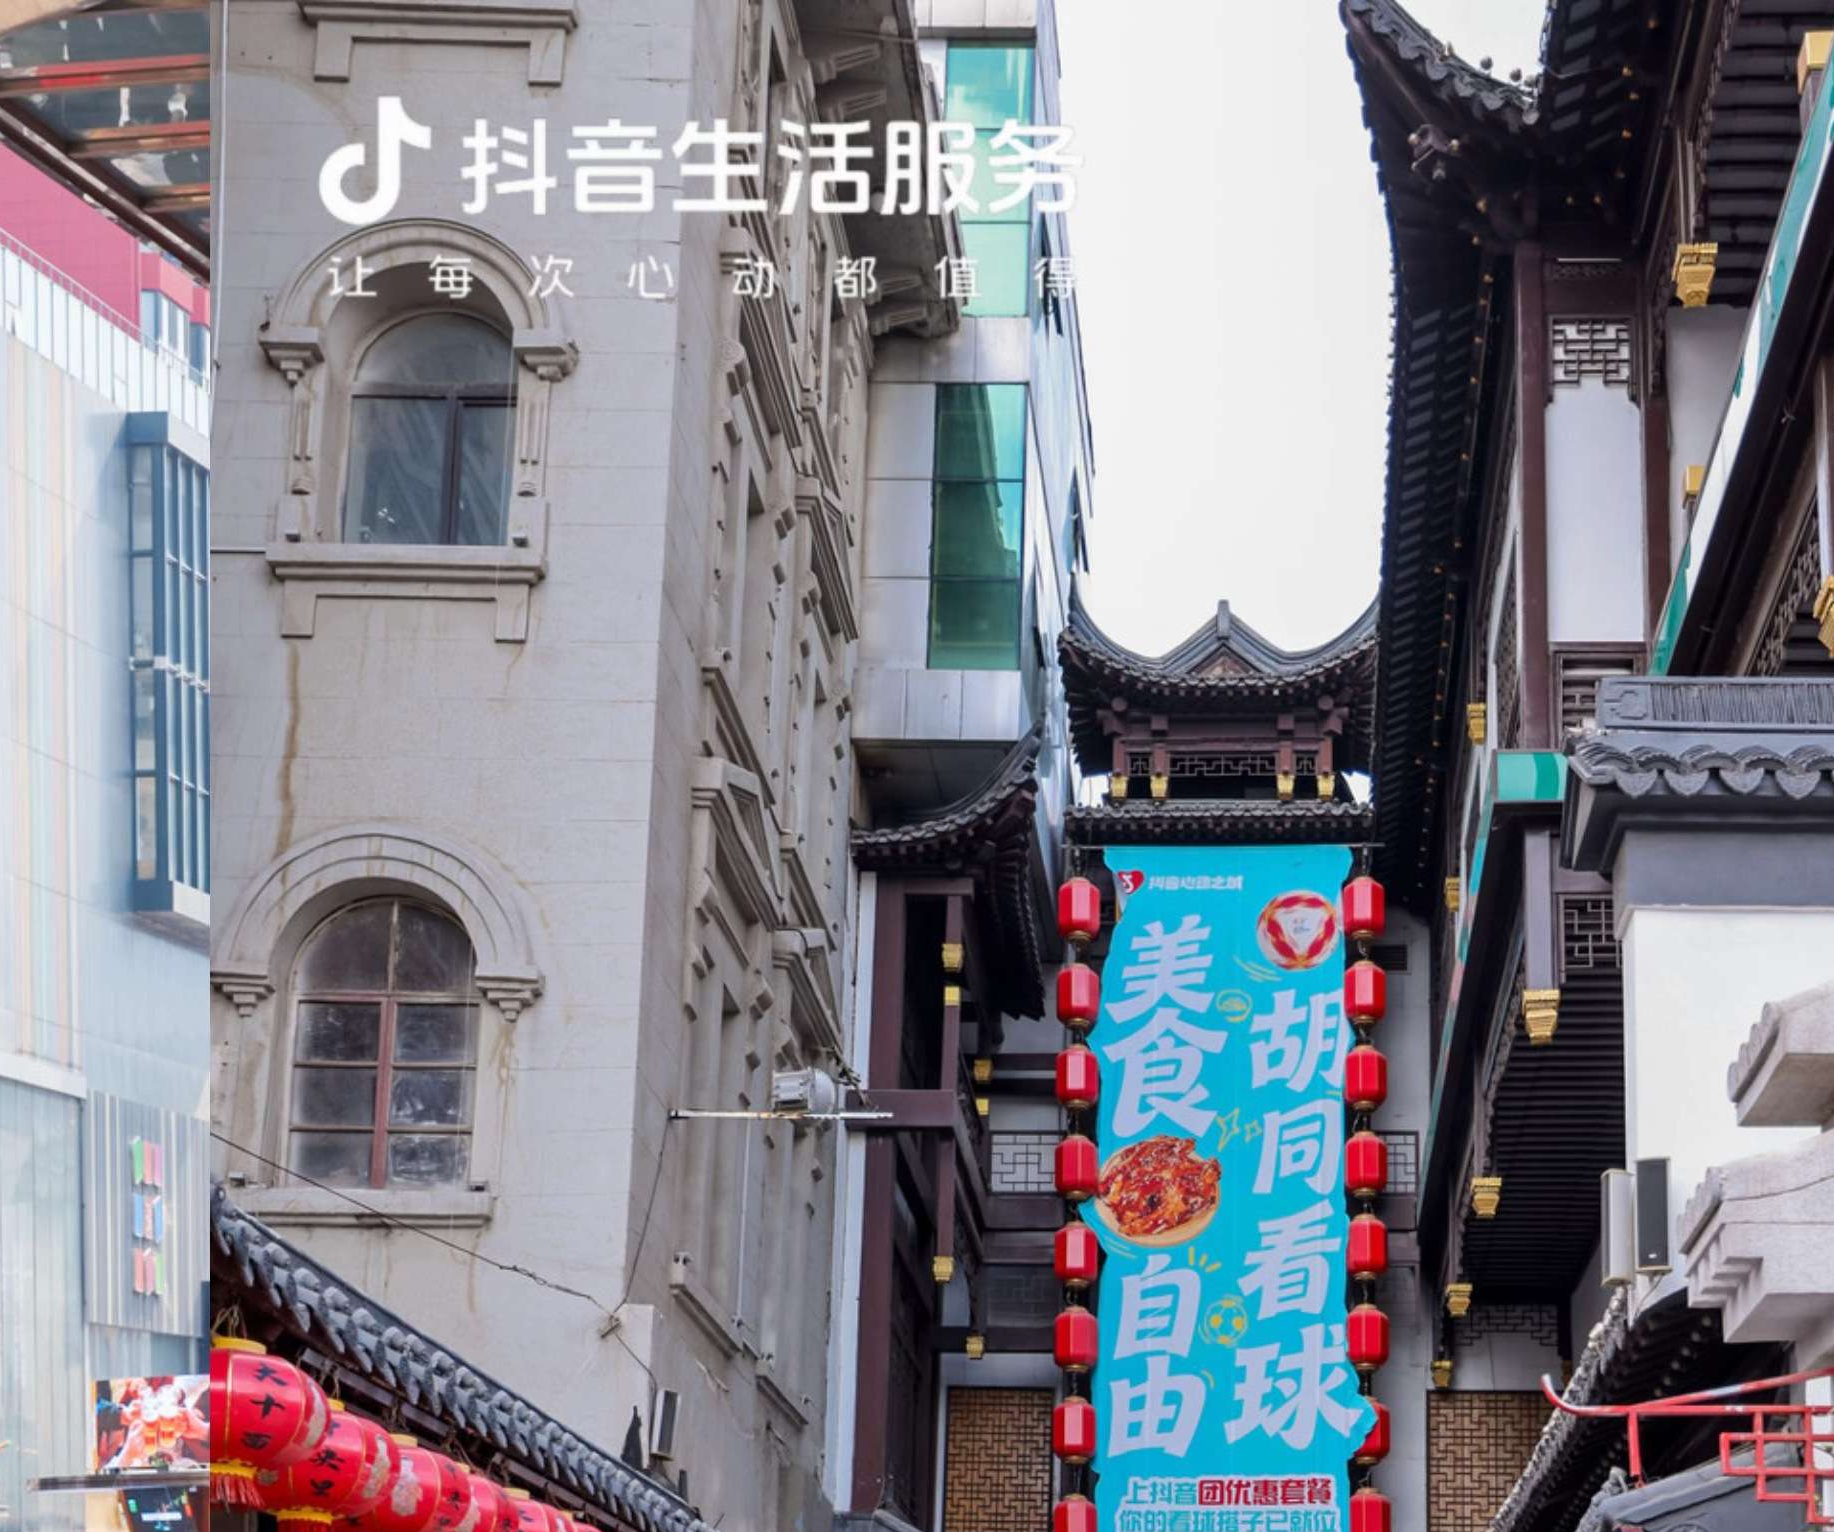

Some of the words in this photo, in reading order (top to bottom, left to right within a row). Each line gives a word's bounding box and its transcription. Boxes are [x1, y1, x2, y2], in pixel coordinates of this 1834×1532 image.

[1125, 1477, 1333, 1508] 上抖音团优惠套餐
